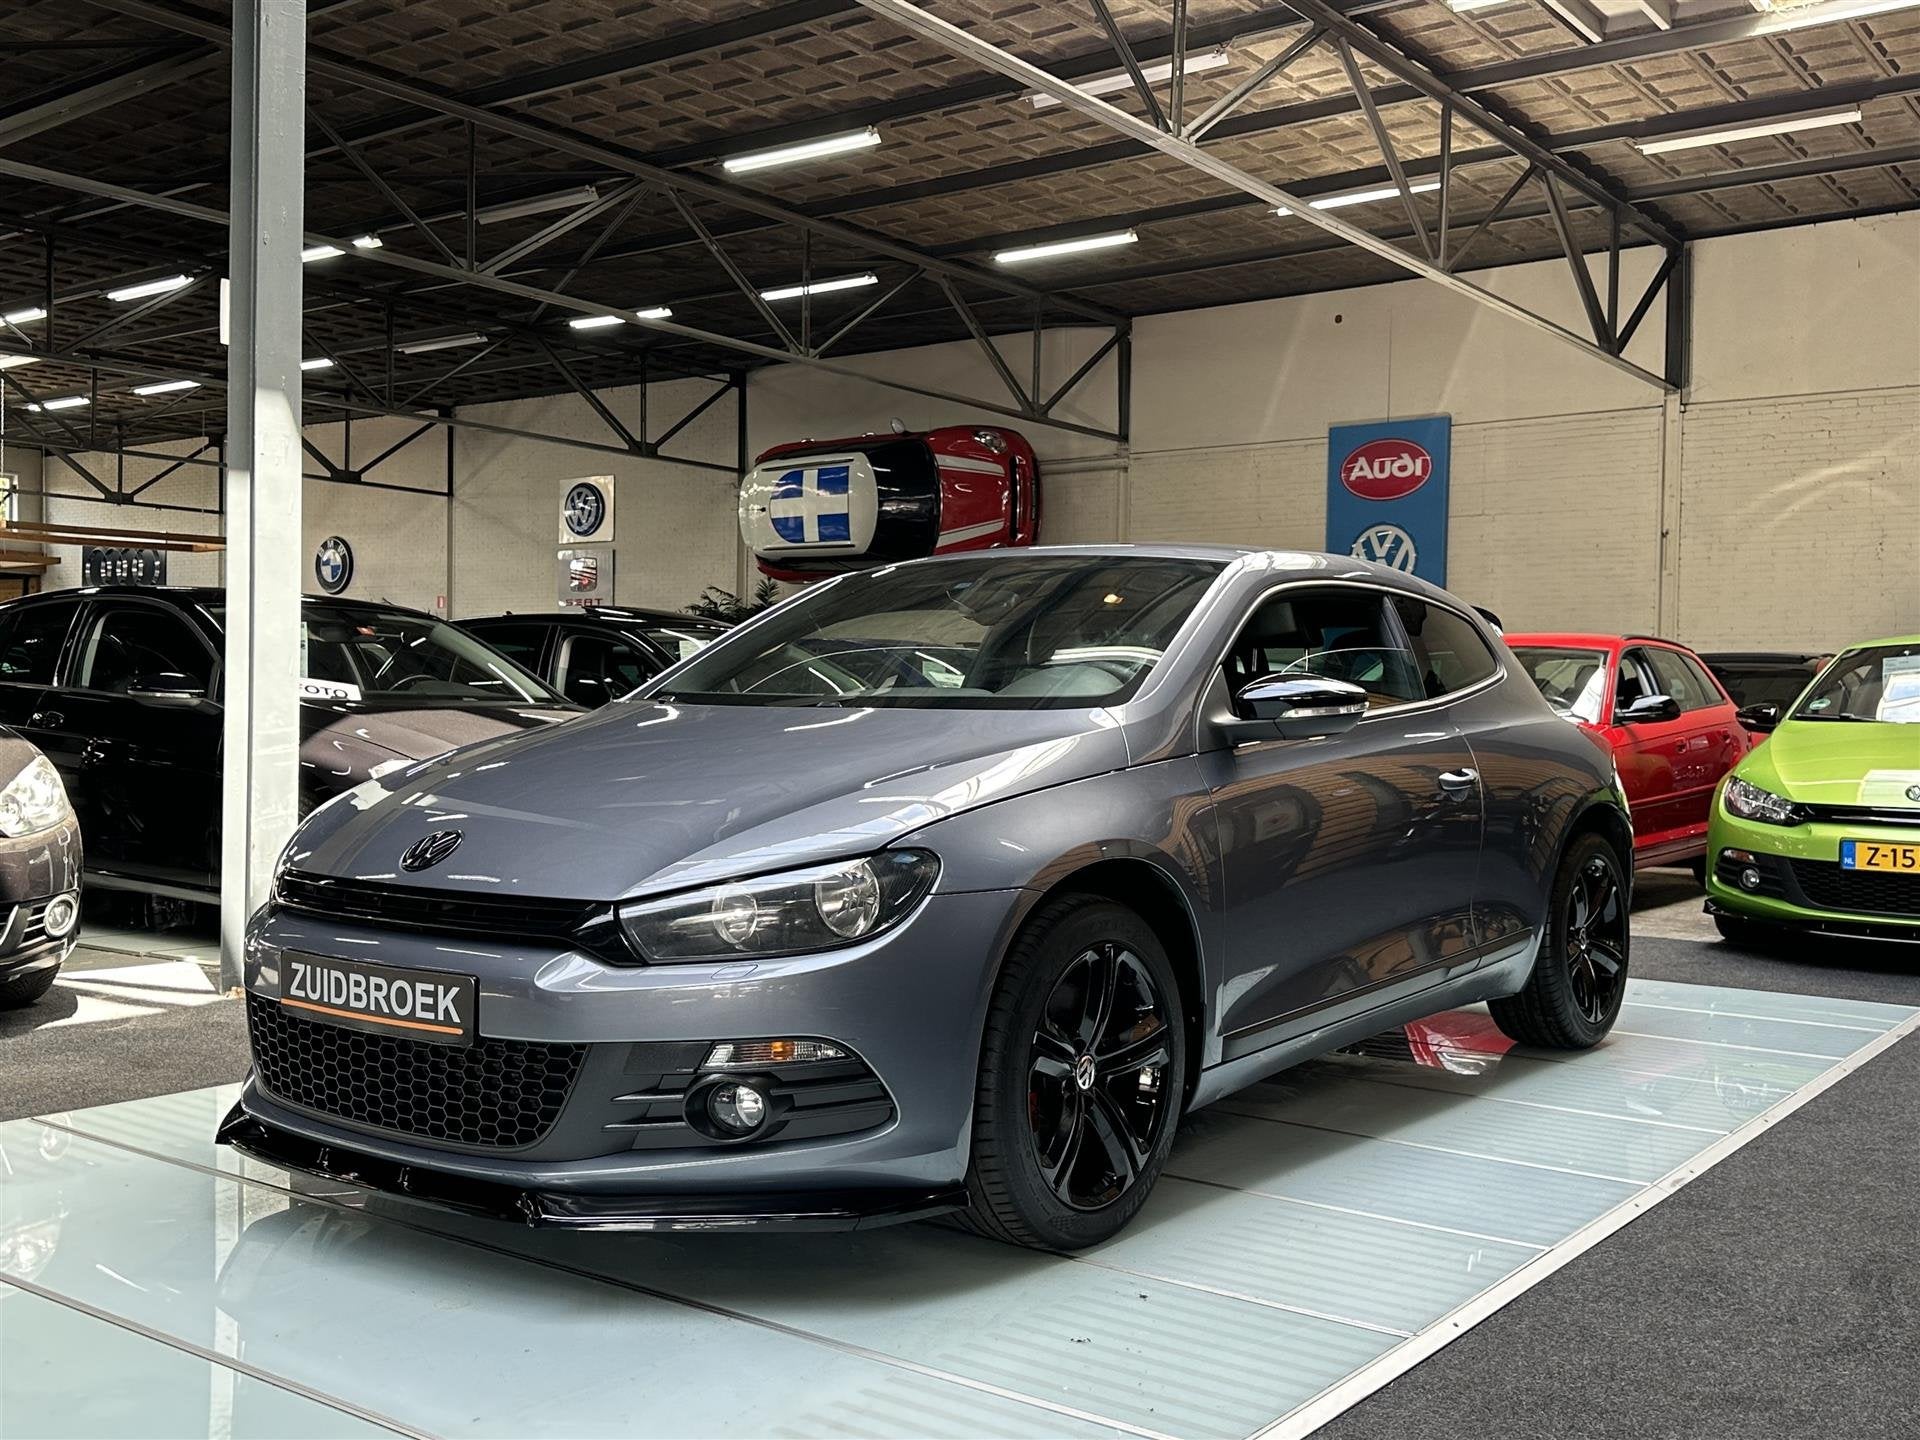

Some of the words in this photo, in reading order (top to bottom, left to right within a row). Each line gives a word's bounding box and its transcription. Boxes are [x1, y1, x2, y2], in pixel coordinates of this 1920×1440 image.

[1349, 452, 1423, 482] Audi
[317, 539, 346, 558] BMW
[565, 597, 603, 608] SEAT
[299, 683, 348, 698] OTO
[1844, 857, 1854, 865] NL
[1866, 847, 1919, 868] Z-15
[290, 962, 461, 1024] ZUIDBROEK
